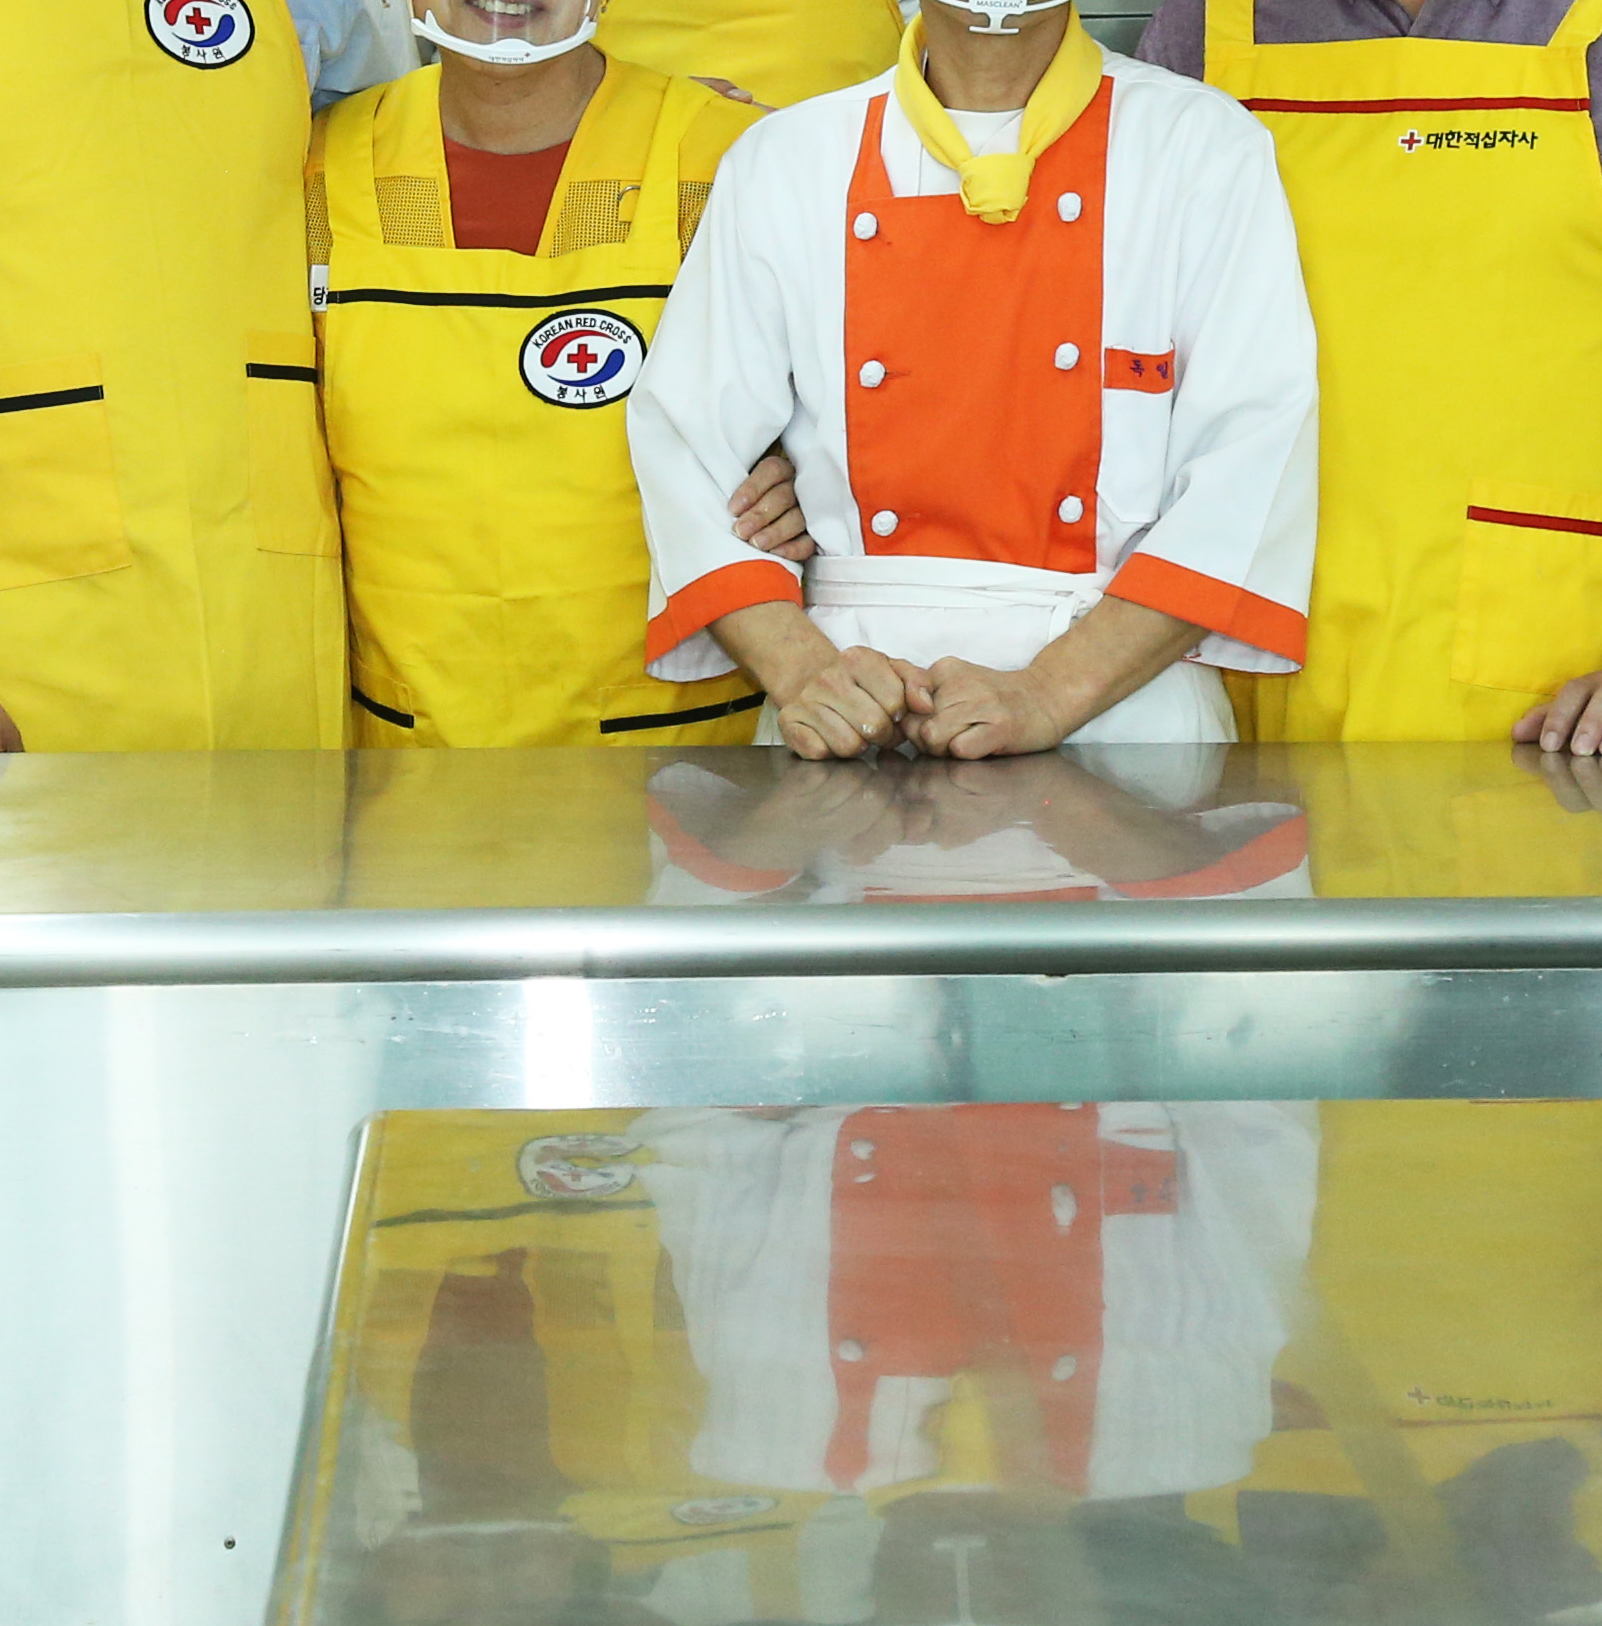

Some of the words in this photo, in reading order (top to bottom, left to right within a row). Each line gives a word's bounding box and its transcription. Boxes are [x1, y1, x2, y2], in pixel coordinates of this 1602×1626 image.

[1426, 130, 1538, 150] 대한적십자사
[314, 286, 328, 305] 당
[532, 319, 573, 349] KOREAN
[576, 317, 597, 328] RED
[599, 320, 632, 344] CROSS
[557, 384, 607, 403] 봉사원
